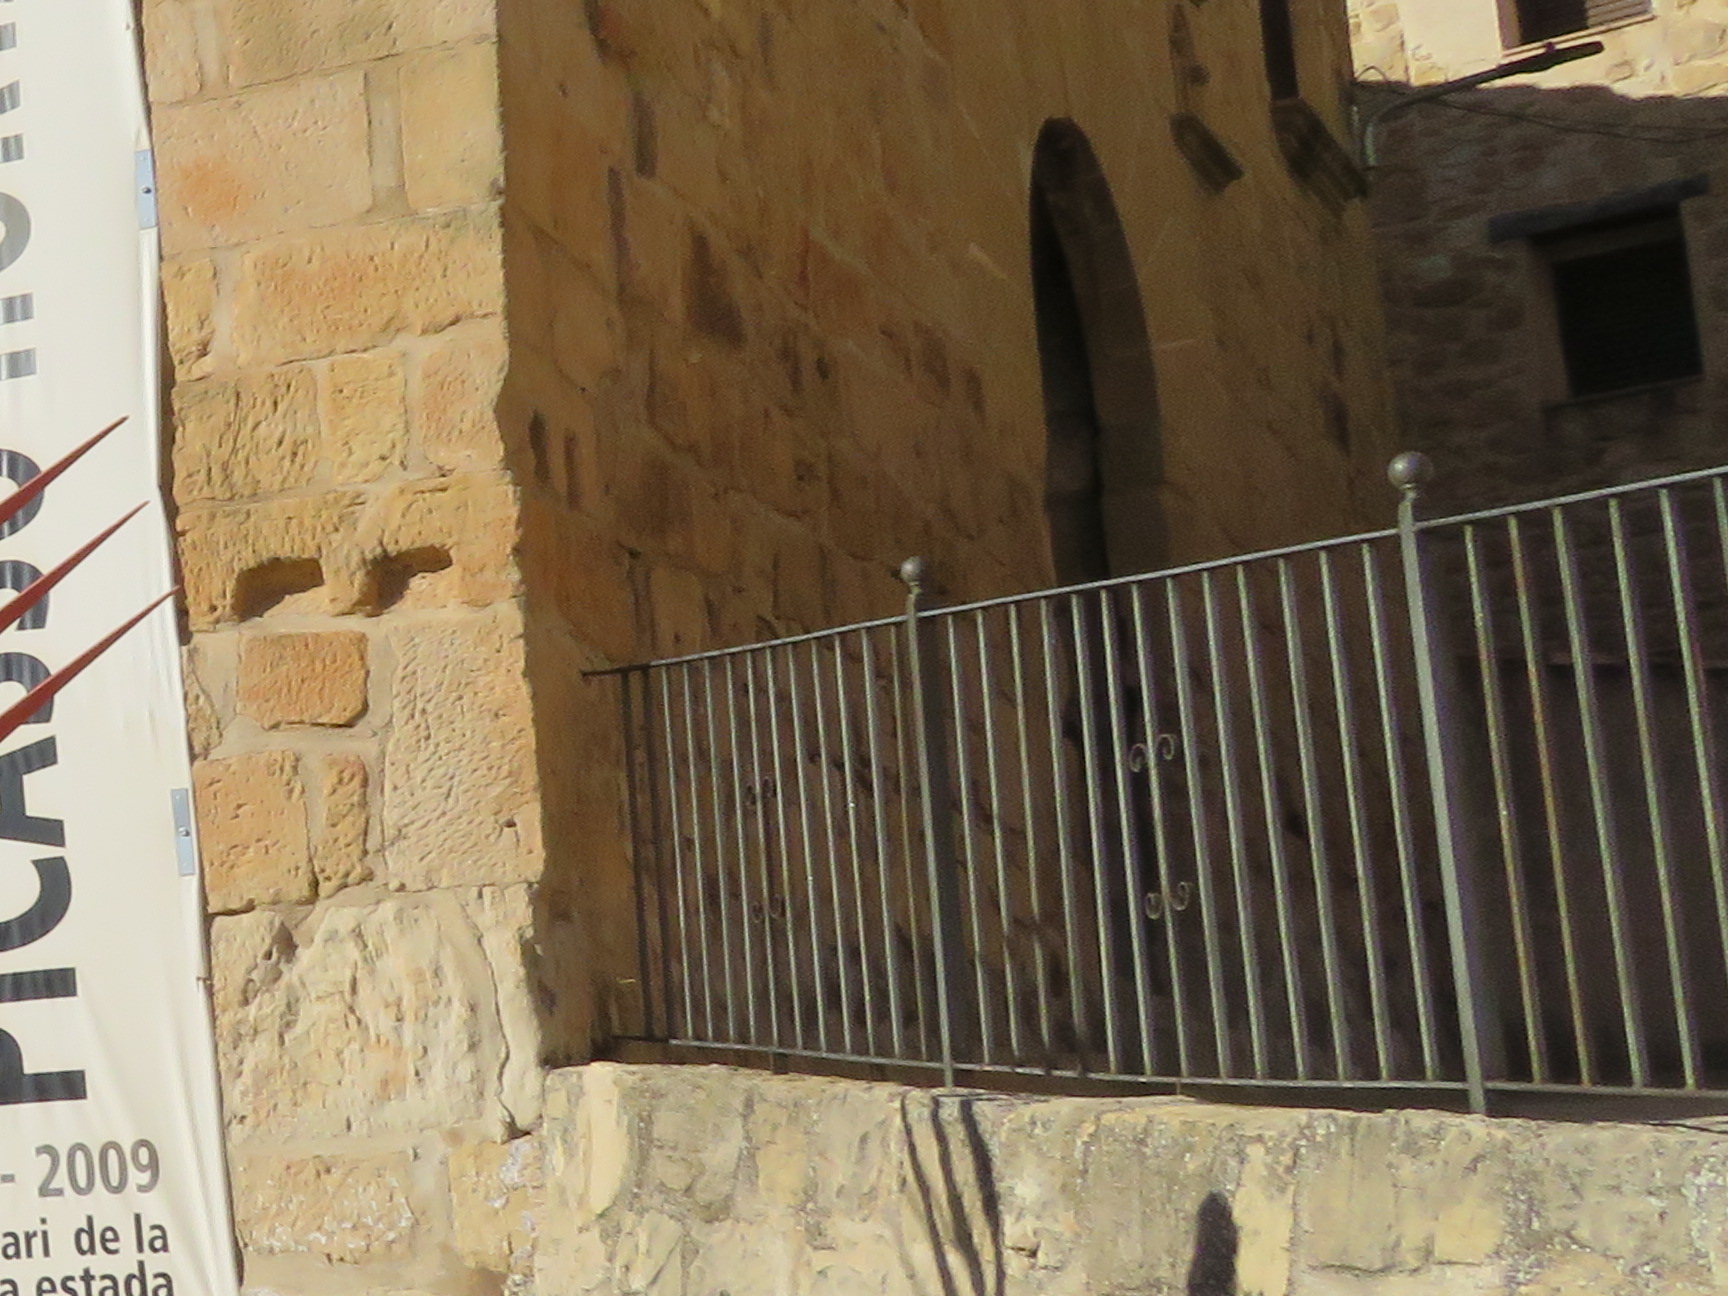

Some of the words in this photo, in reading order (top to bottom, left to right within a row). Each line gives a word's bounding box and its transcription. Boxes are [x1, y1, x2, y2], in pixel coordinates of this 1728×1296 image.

[35, 1138, 160, 1198] 2009
[74, 1214, 121, 1256] de
[133, 1212, 170, 1254] la
